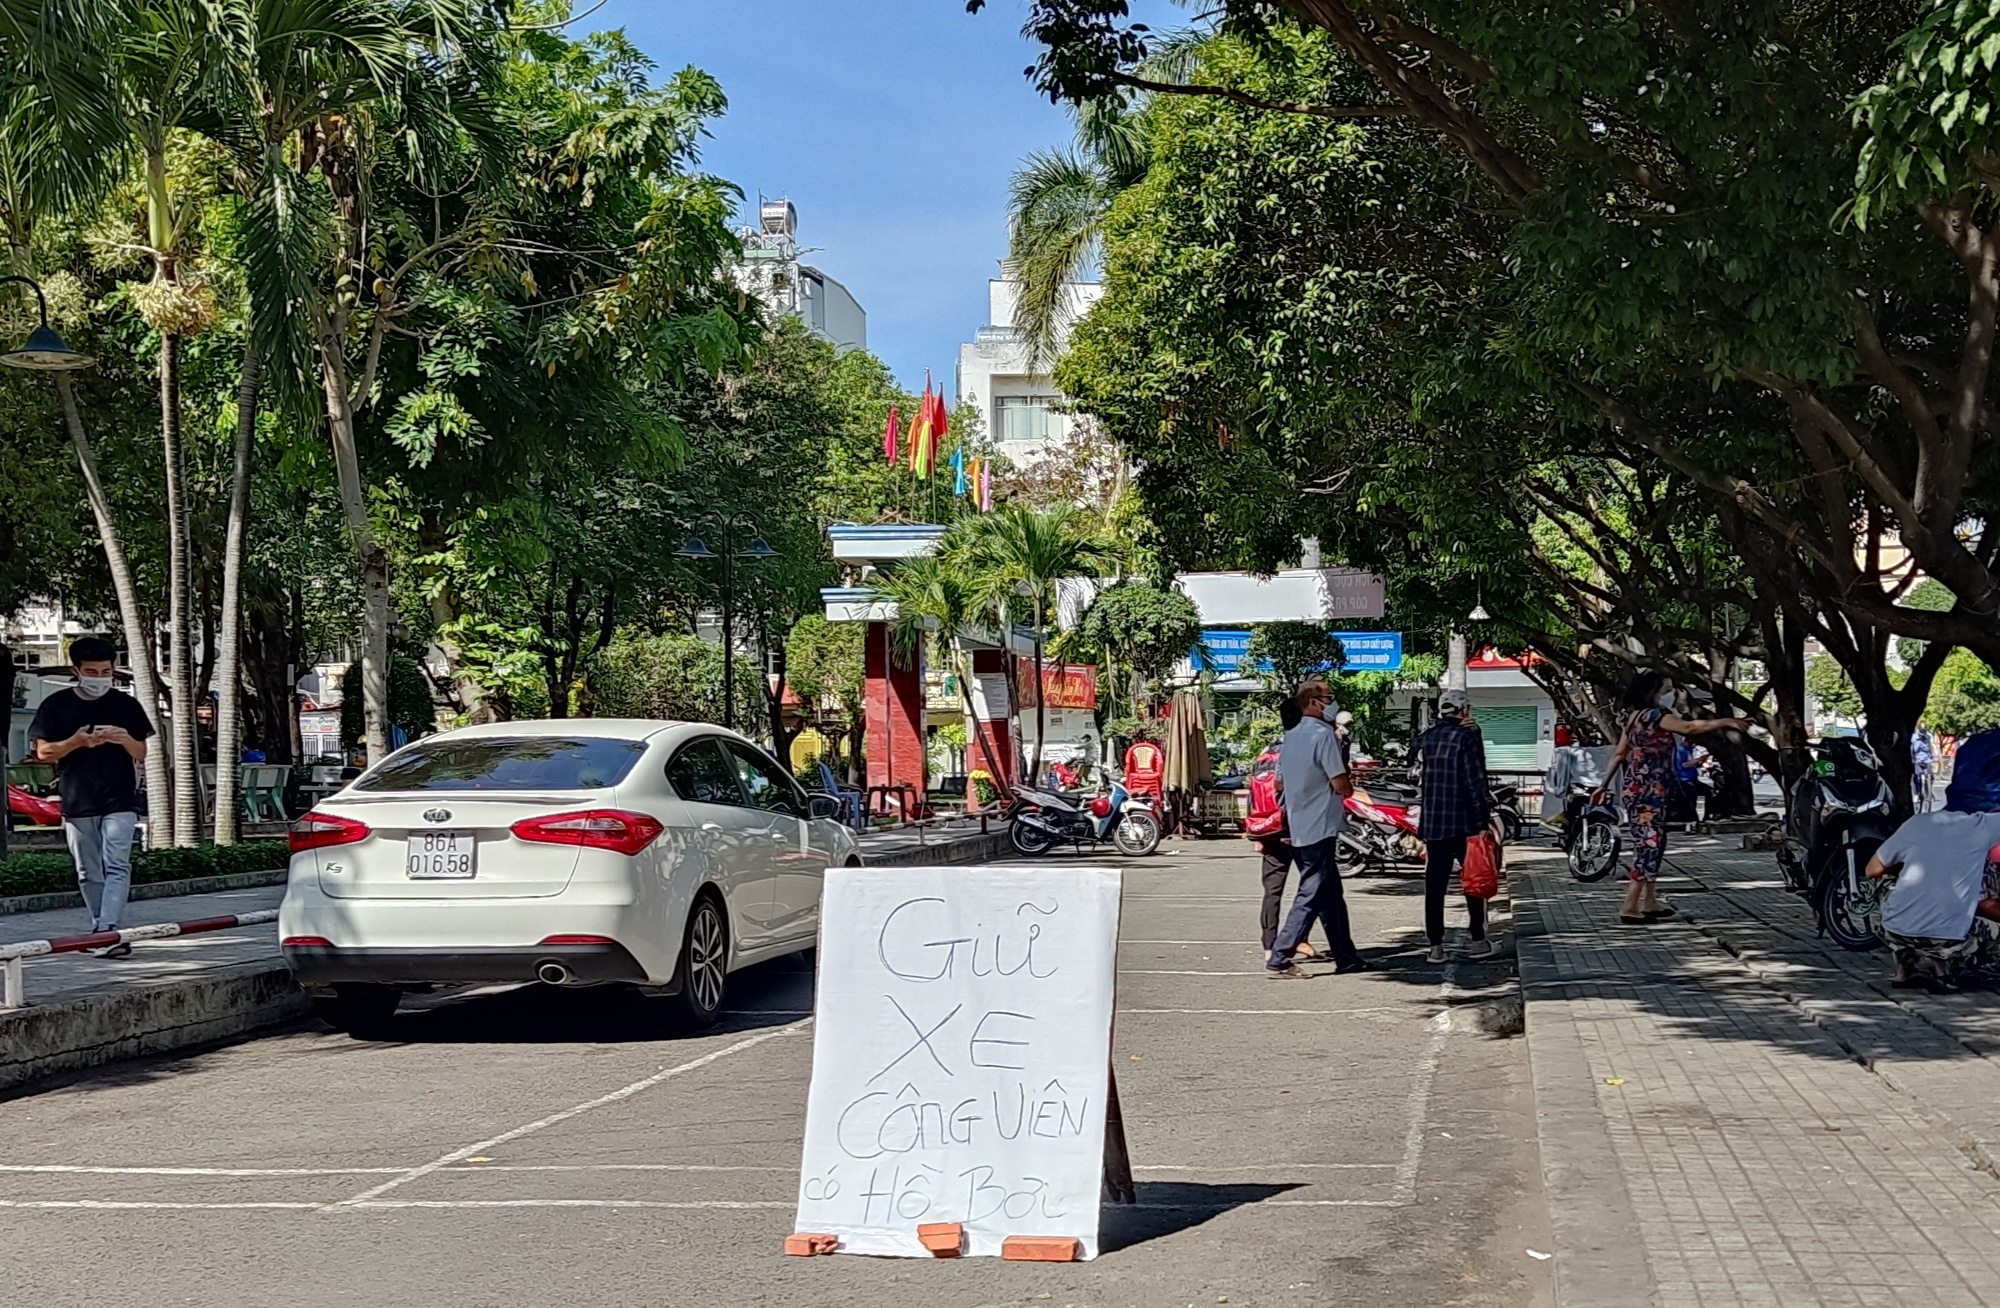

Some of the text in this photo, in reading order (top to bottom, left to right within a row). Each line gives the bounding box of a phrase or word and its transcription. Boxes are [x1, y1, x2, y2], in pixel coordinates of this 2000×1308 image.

[426, 810, 447, 821] KIA
[424, 833, 457, 852] 86A
[325, 862, 344, 874] K3
[409, 854, 470, 873] 016.58
[866, 994, 1036, 1087] XE
